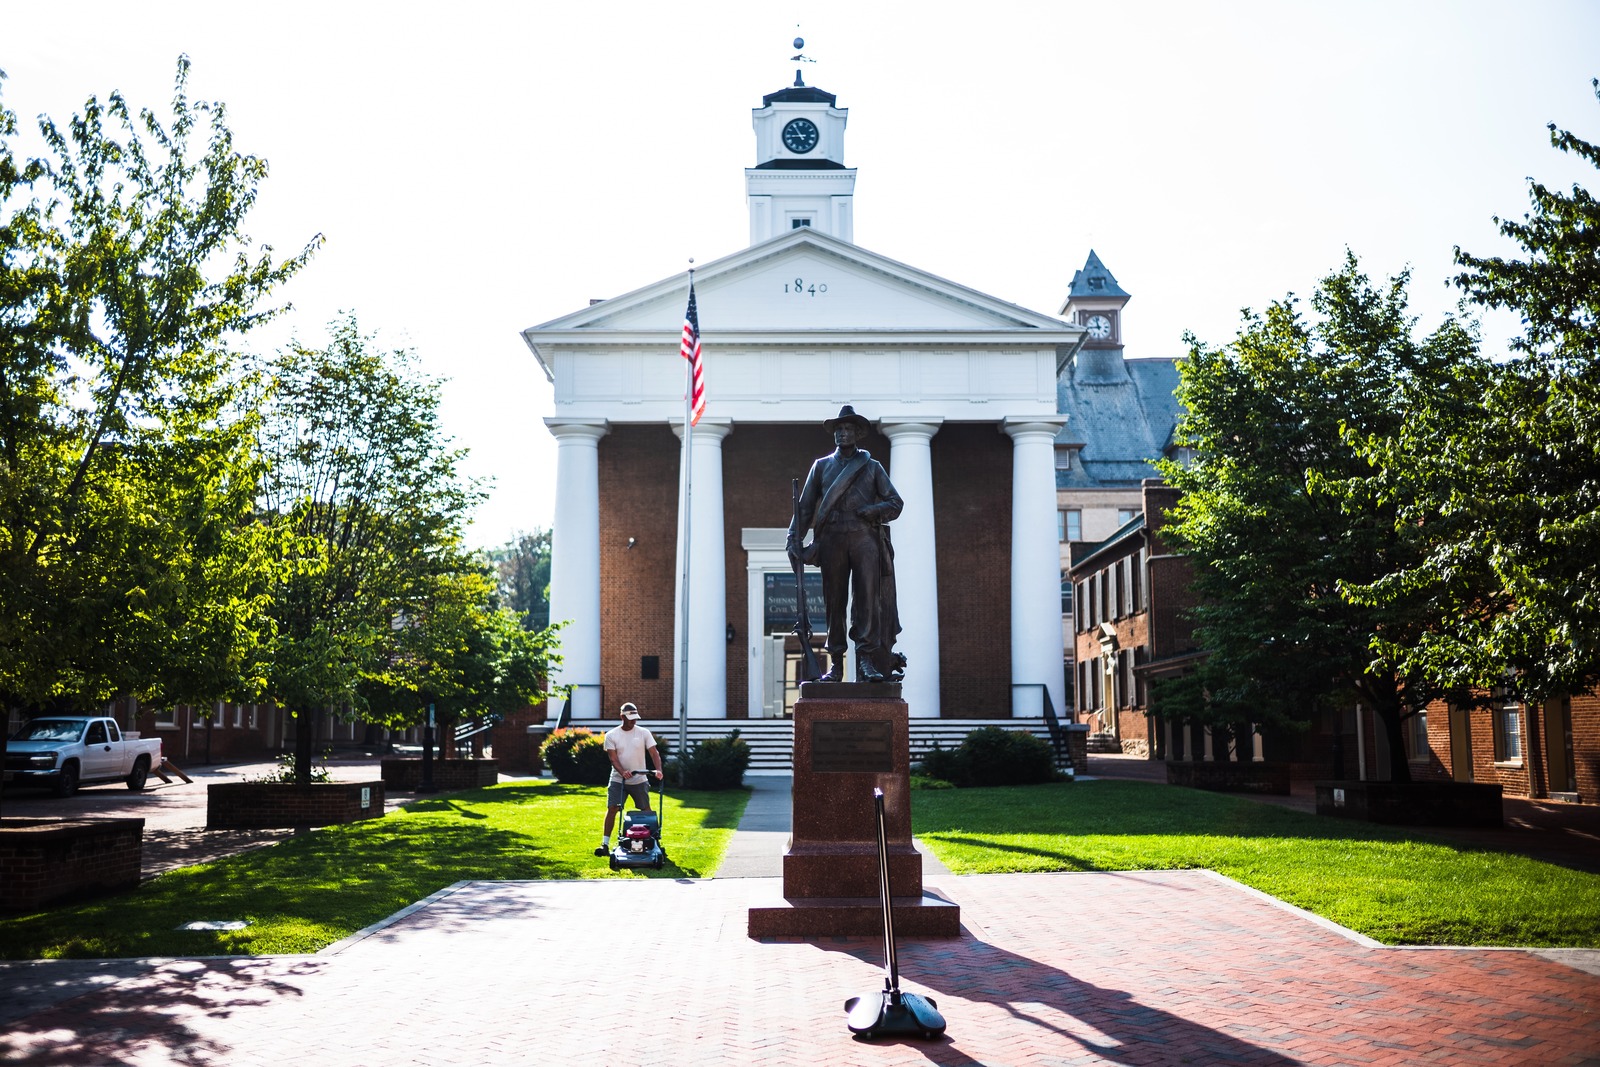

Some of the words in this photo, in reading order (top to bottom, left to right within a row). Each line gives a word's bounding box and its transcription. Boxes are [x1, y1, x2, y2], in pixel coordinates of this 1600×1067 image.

[784, 277, 828, 297] 1840
[768, 596, 816, 604] SHENANAH
[769, 605, 788, 613] CIVIL
